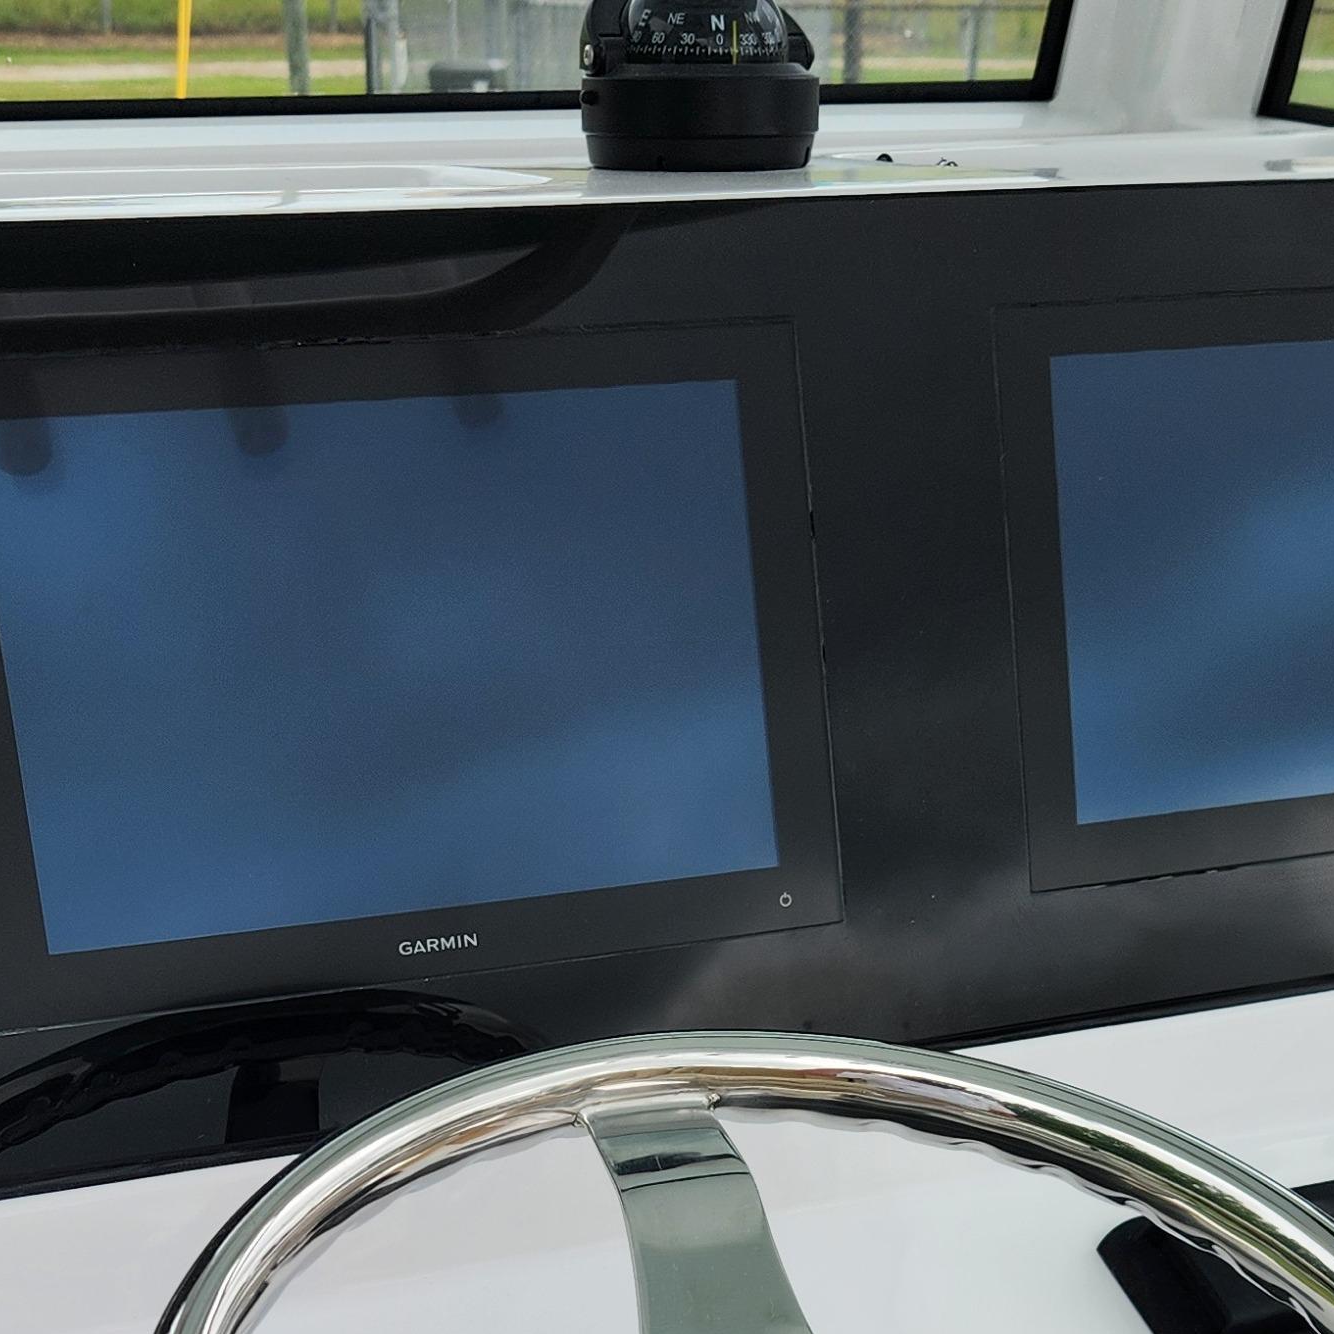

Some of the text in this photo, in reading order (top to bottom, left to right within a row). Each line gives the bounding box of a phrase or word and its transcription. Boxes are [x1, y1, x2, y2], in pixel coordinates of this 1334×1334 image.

[668, 12, 685, 24] NE
[710, 14, 725, 31] N
[651, 31, 665, 44] 60
[680, 32, 695, 45] 30
[716, 33, 724, 45] 0
[398, 933, 479, 957] GARMIN
